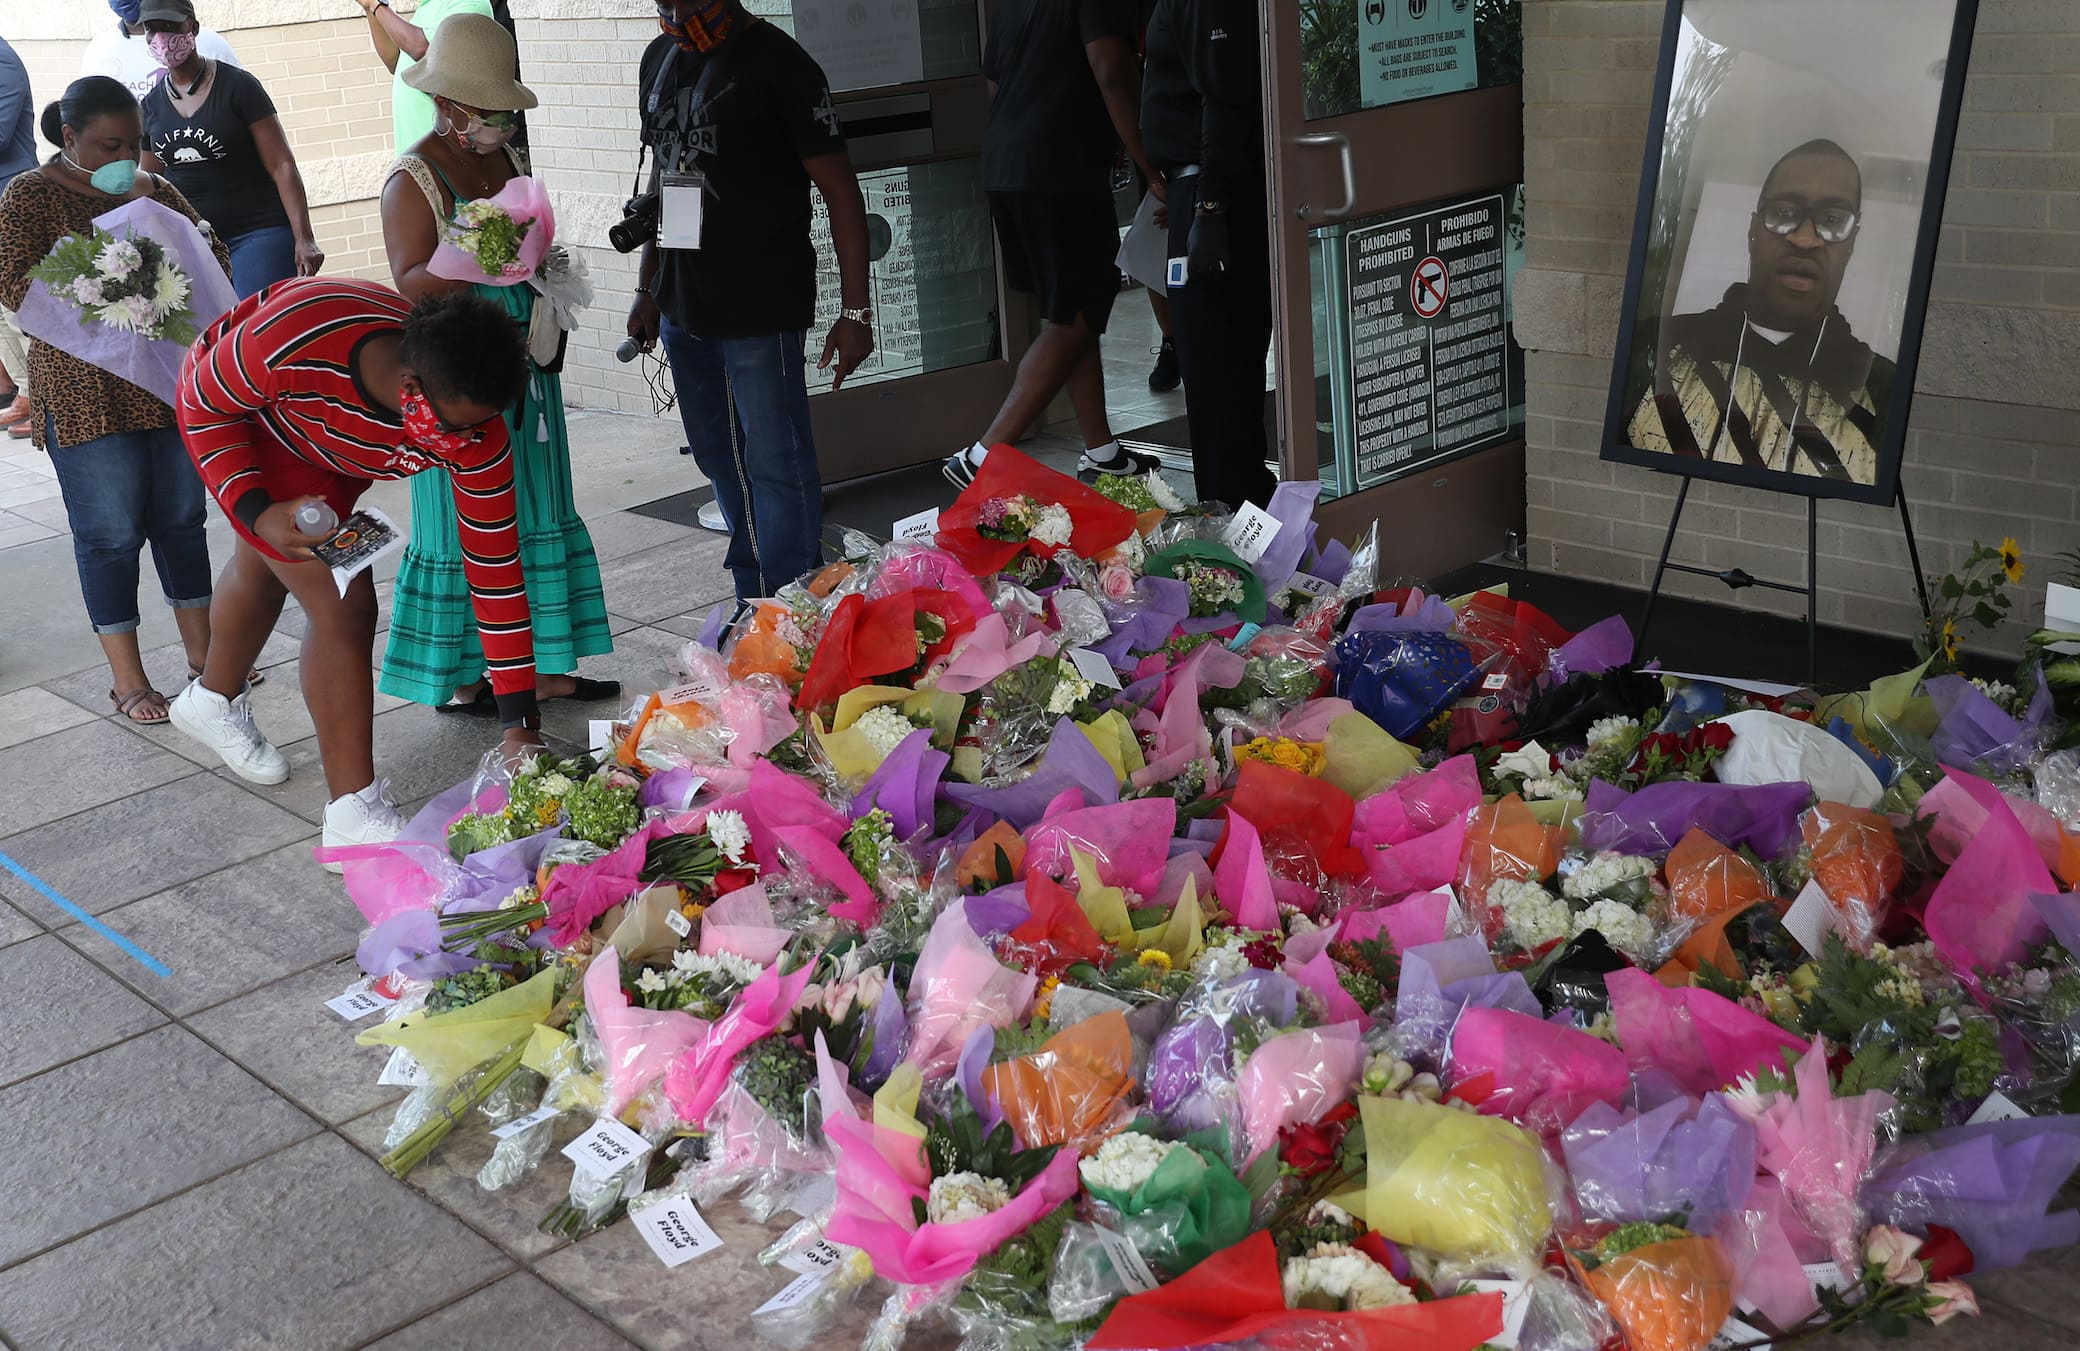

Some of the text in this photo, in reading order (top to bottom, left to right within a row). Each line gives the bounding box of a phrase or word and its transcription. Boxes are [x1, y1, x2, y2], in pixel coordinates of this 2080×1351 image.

[1441, 208, 1488, 232] PROHIBIDO
[1360, 228, 1412, 253] HANDGUNS
[1436, 225, 1494, 252] ARMAS DE FUEGO
[1358, 246, 1414, 272] PROHIBITED
[1234, 514, 1257, 546] George
[1244, 522, 1264, 550] Floyd
[346, 998, 368, 1010] Floyd
[355, 993, 379, 1008] George
[587, 1141, 618, 1162] Floyd
[596, 1131, 630, 1156] George
[657, 1220, 687, 1249] Floyd
[667, 1211, 699, 1247] George
[816, 1240, 841, 1259] orge
